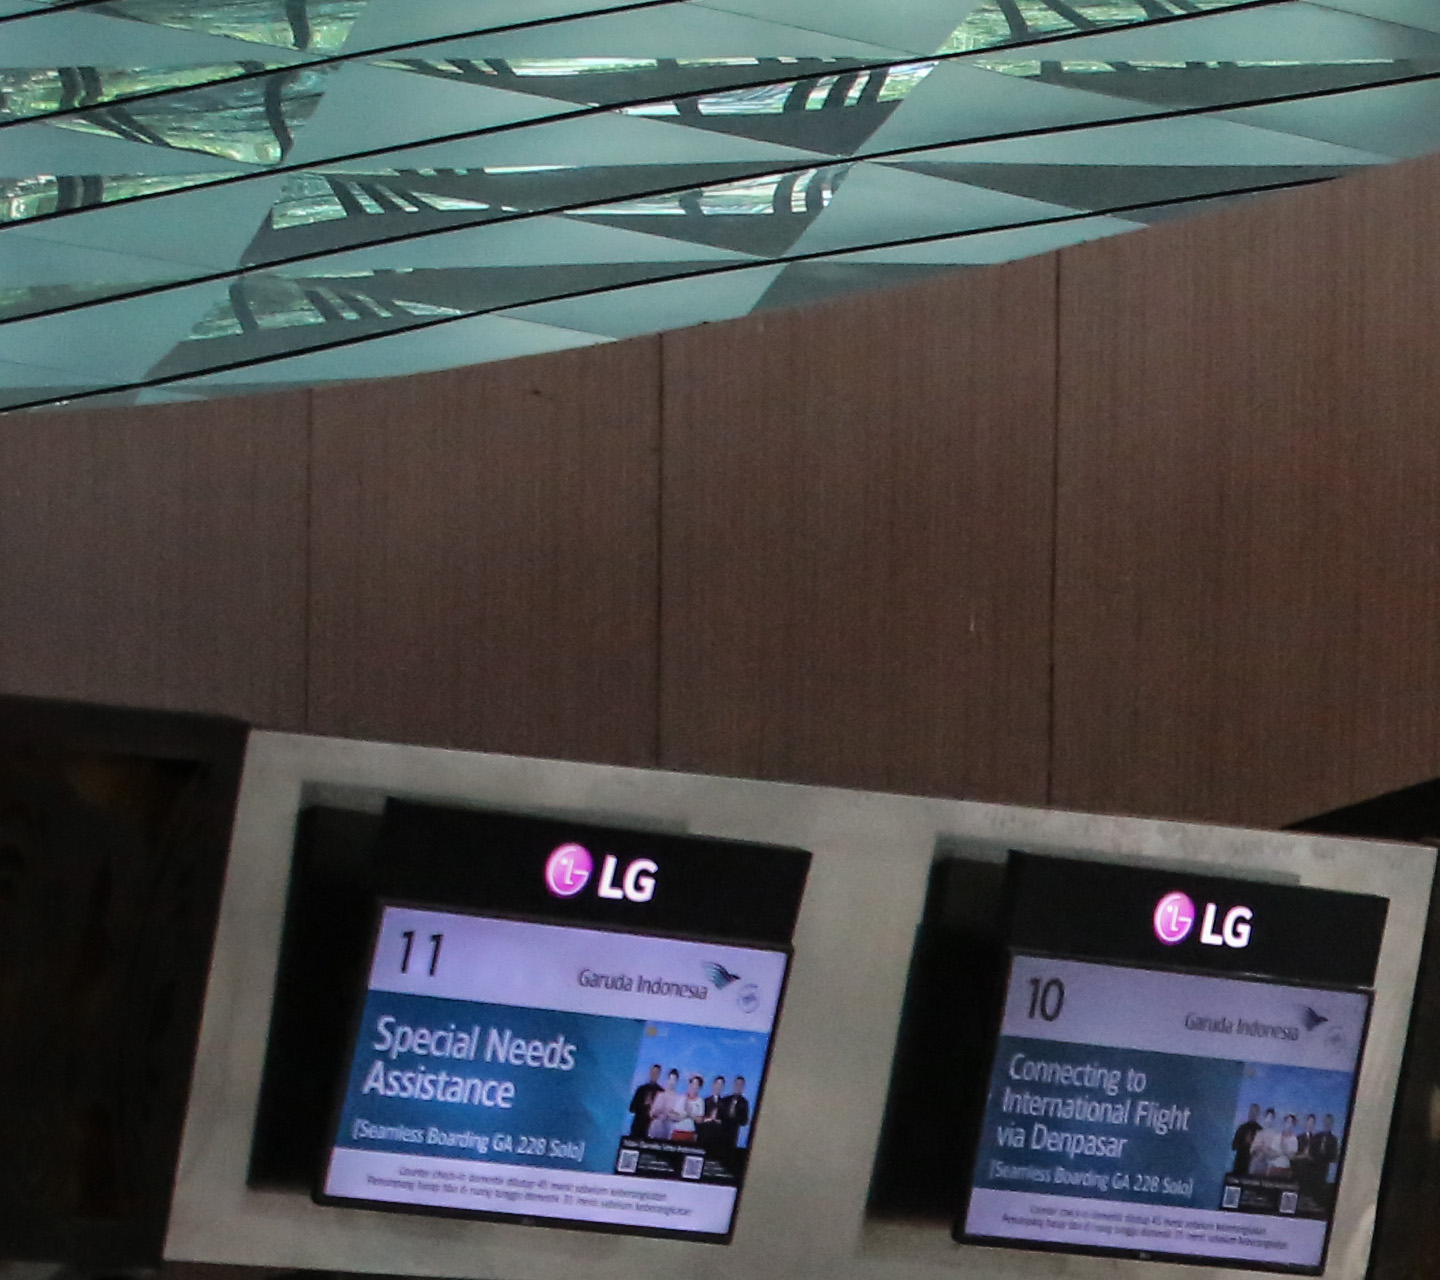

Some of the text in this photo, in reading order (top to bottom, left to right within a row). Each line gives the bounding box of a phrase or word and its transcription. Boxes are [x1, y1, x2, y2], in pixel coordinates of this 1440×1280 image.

[598, 853, 658, 903] LG
[1200, 903, 1253, 949] LG
[400, 930, 444, 976] 11
[578, 968, 708, 1000] Garuda Indonesia
[1027, 977, 1064, 1022] 10
[373, 1015, 576, 1071] Special Needs
[1185, 1014, 1299, 1041] Garuda Indonesia
[362, 1059, 516, 1108] Assistance
[1009, 1052, 1147, 1095] Connecting to
[1002, 1088, 1191, 1135] International Flight
[428, 1128, 488, 1153] Boarding
[495, 1135, 513, 1152] GA
[517, 1136, 544, 1155] 228
[996, 1124, 1128, 1159] via Denpasar
